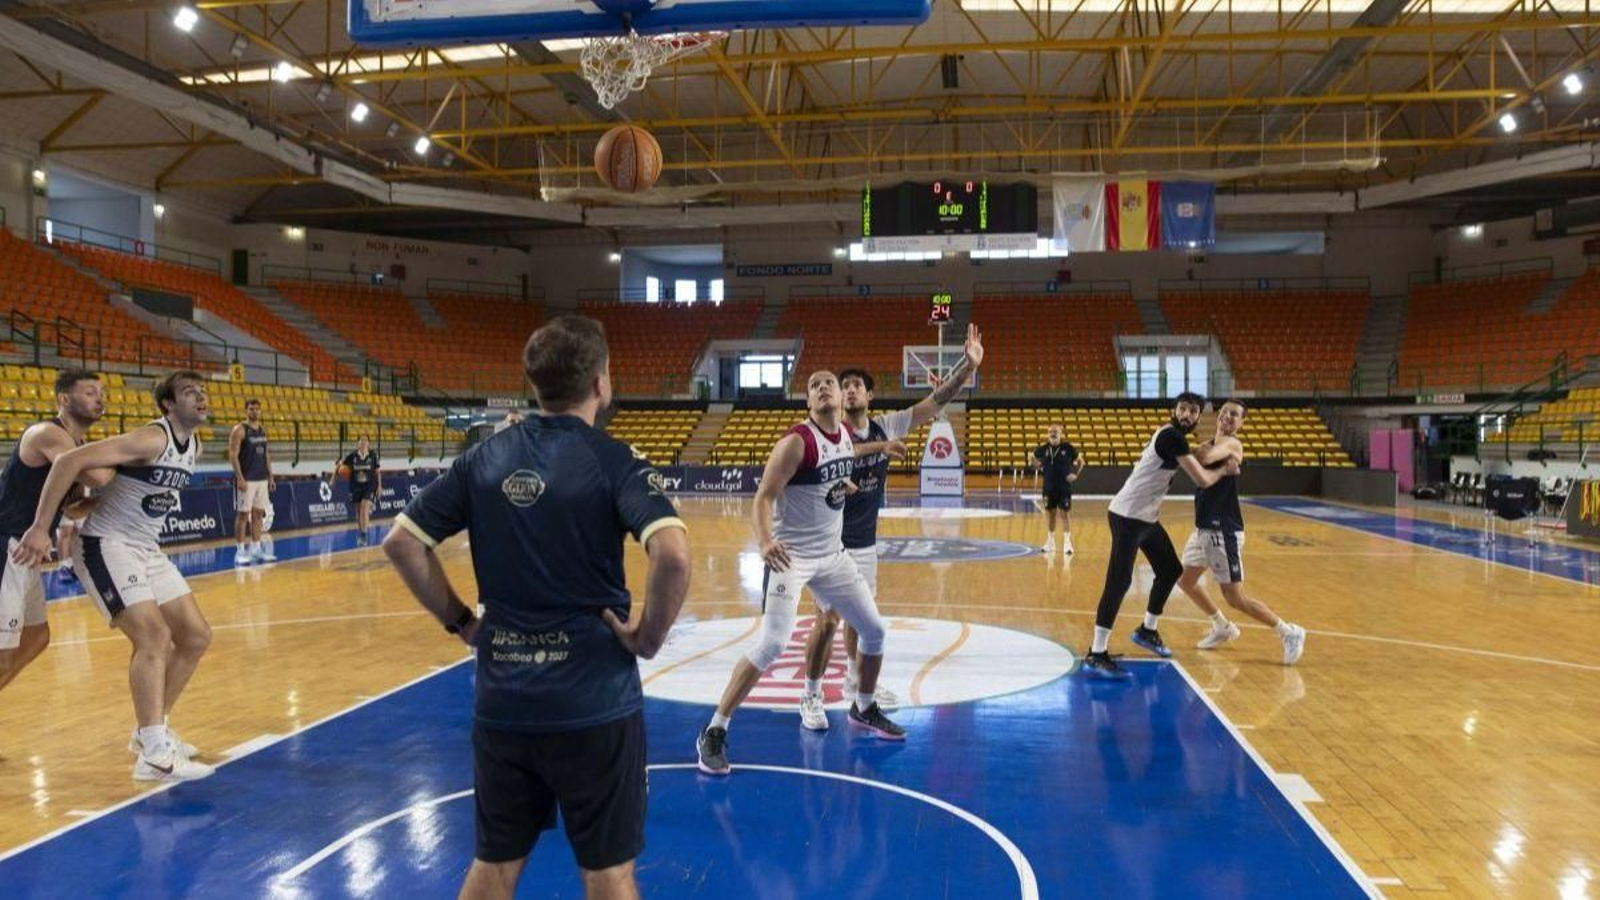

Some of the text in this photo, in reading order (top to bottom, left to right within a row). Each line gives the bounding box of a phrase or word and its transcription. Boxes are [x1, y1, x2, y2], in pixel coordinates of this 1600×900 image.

[934, 181, 973, 193] 0 0
[939, 204, 963, 215] 10:00
[739, 265, 830, 275] FONDO NORTE
[931, 305, 950, 319] 24
[168, 514, 216, 533] Penedo
[492, 651, 532, 662] Xacobeo
